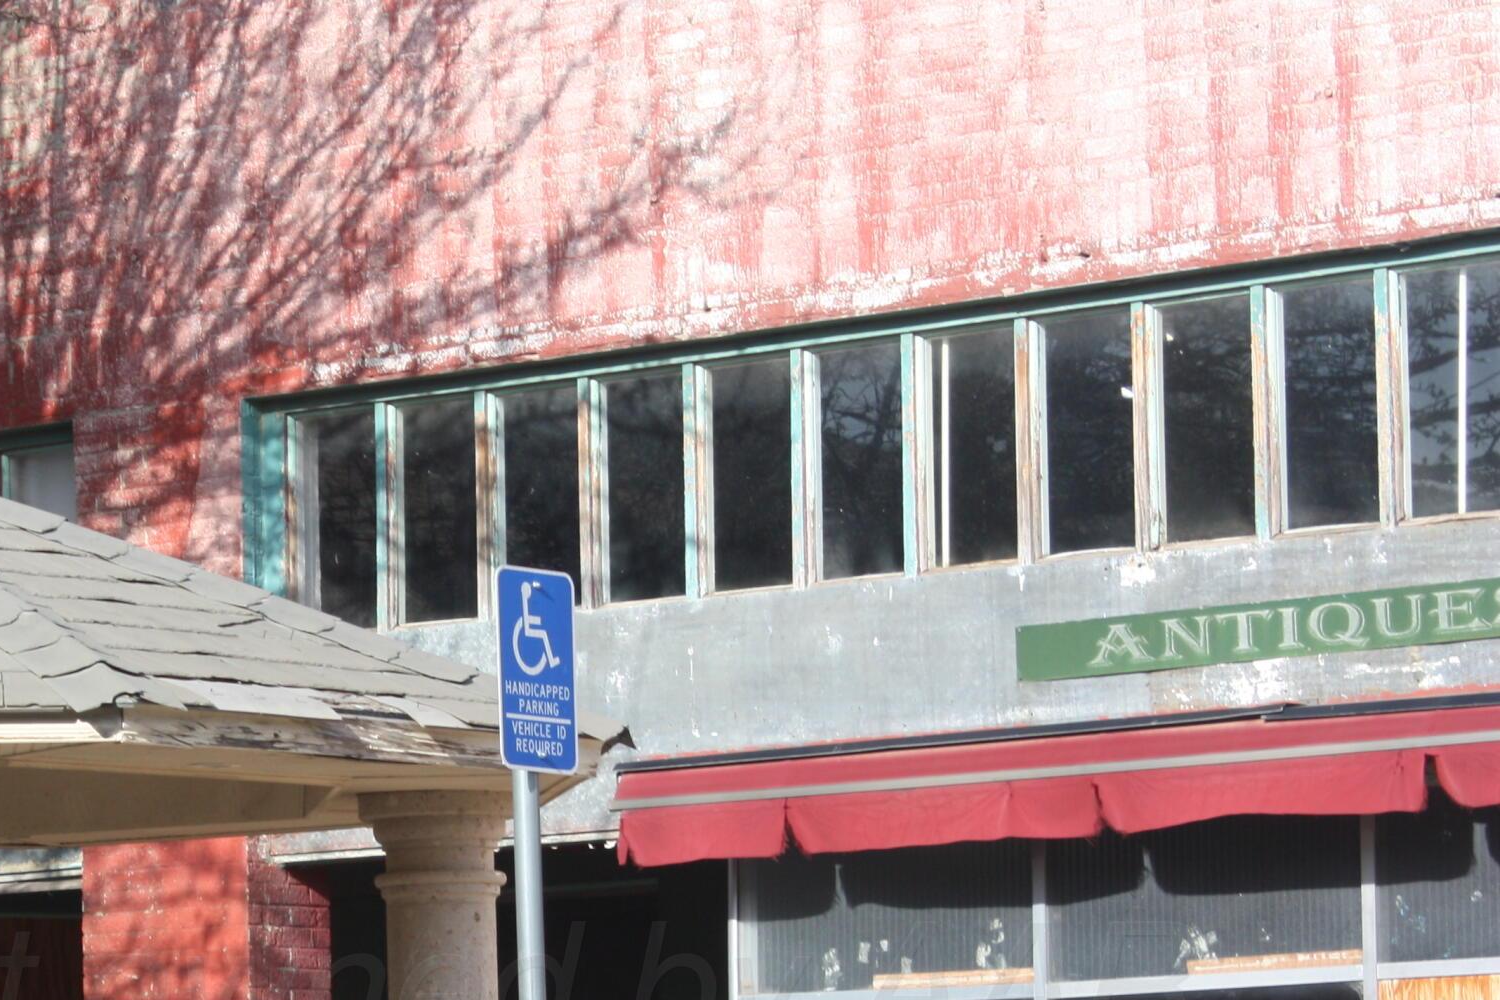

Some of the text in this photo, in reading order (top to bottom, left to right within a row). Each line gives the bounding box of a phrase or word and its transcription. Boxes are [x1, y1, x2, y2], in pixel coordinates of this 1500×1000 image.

[1089, 587, 1500, 667] ANTIQUE
[505, 680, 570, 701] HANDICAPPED
[519, 699, 559, 717] PARKING
[512, 720, 567, 739] VEHICLE ID
[516, 737, 563, 756] REQUIRED
